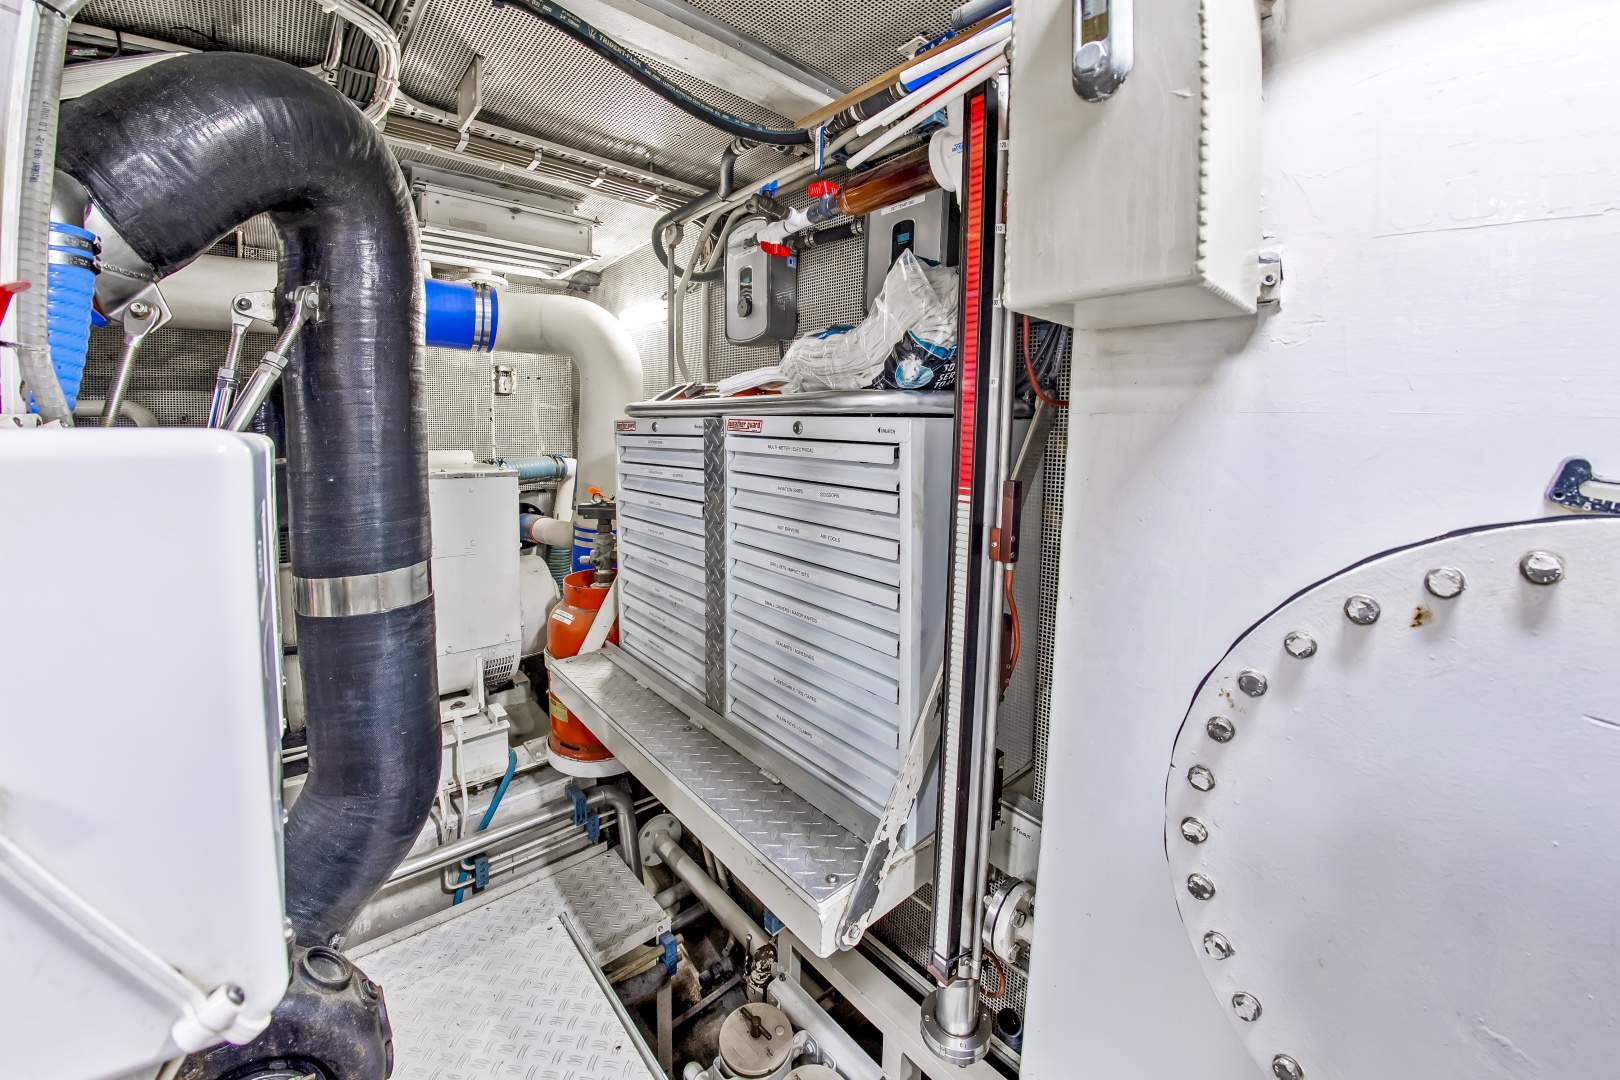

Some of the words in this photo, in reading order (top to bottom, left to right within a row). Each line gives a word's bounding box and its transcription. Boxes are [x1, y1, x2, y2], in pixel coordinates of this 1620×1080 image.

[599, 34, 641, 67] TRIDENT-FLEX
[819, 491, 840, 499] SCISSORS
[828, 535, 841, 543] TOOLS
[797, 726, 813, 739] CLAMPS
